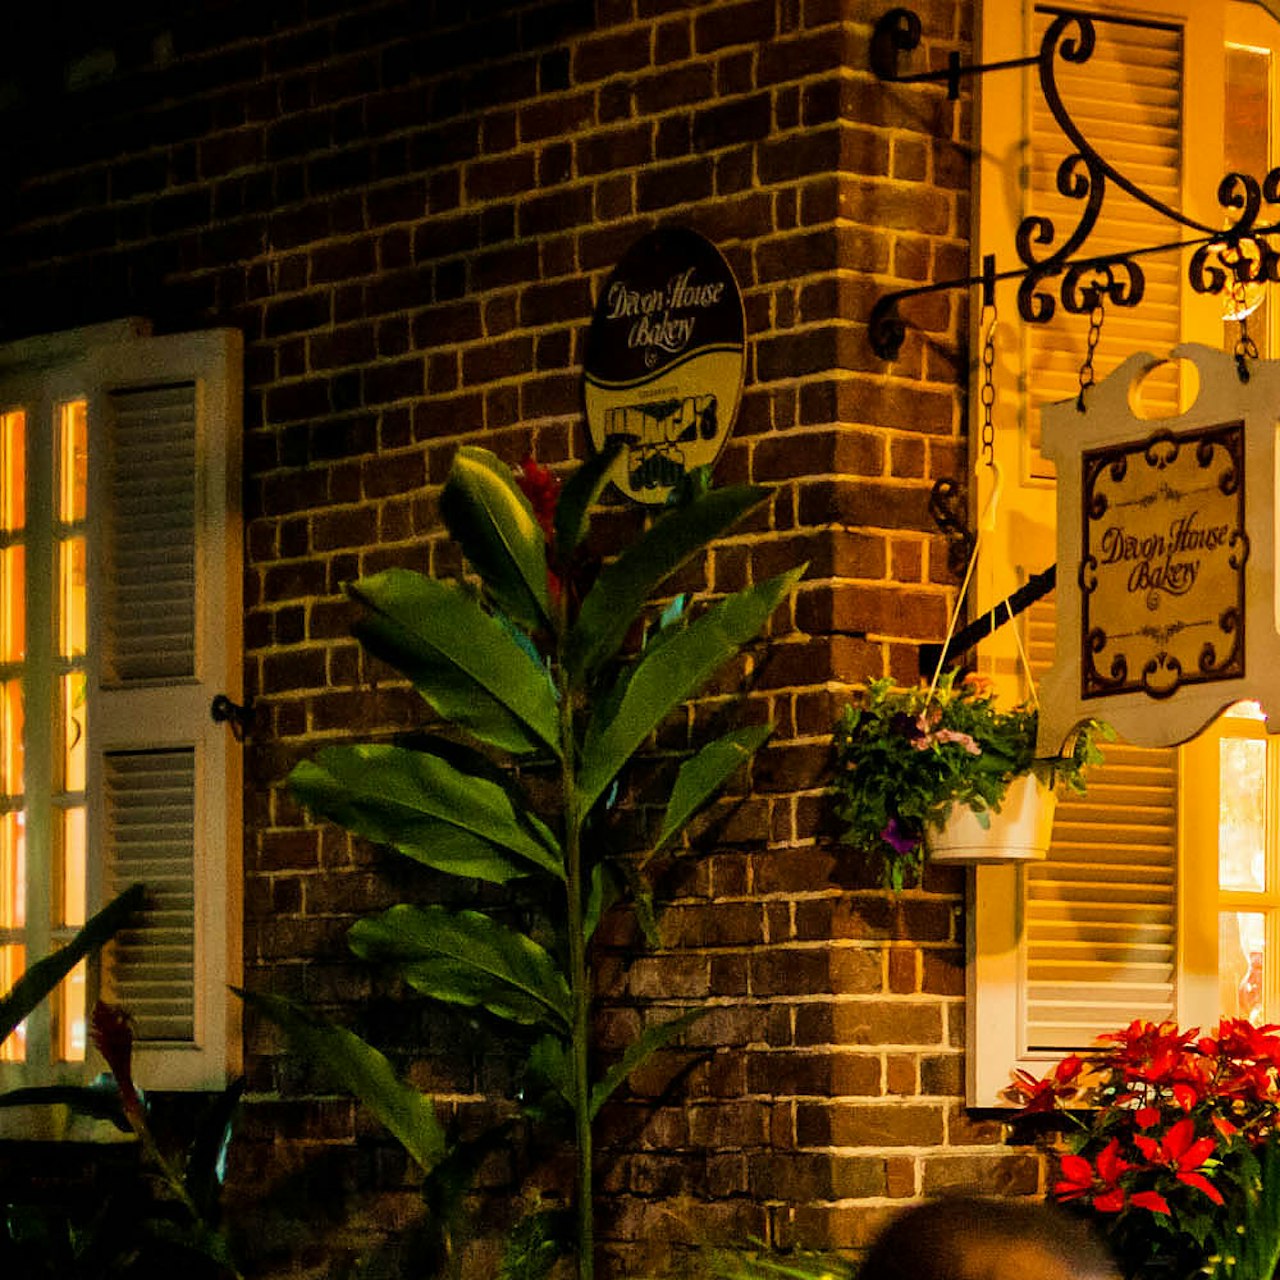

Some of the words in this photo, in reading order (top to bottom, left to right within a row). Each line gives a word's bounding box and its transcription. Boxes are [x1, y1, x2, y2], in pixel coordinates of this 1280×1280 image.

[606, 281, 663, 319] Devon
[667, 266, 724, 308] House
[627, 310, 696, 367] Bakery
[1101, 527, 1165, 564] Devon
[1168, 510, 1229, 555] House
[1127, 556, 1200, 611] Bakery
